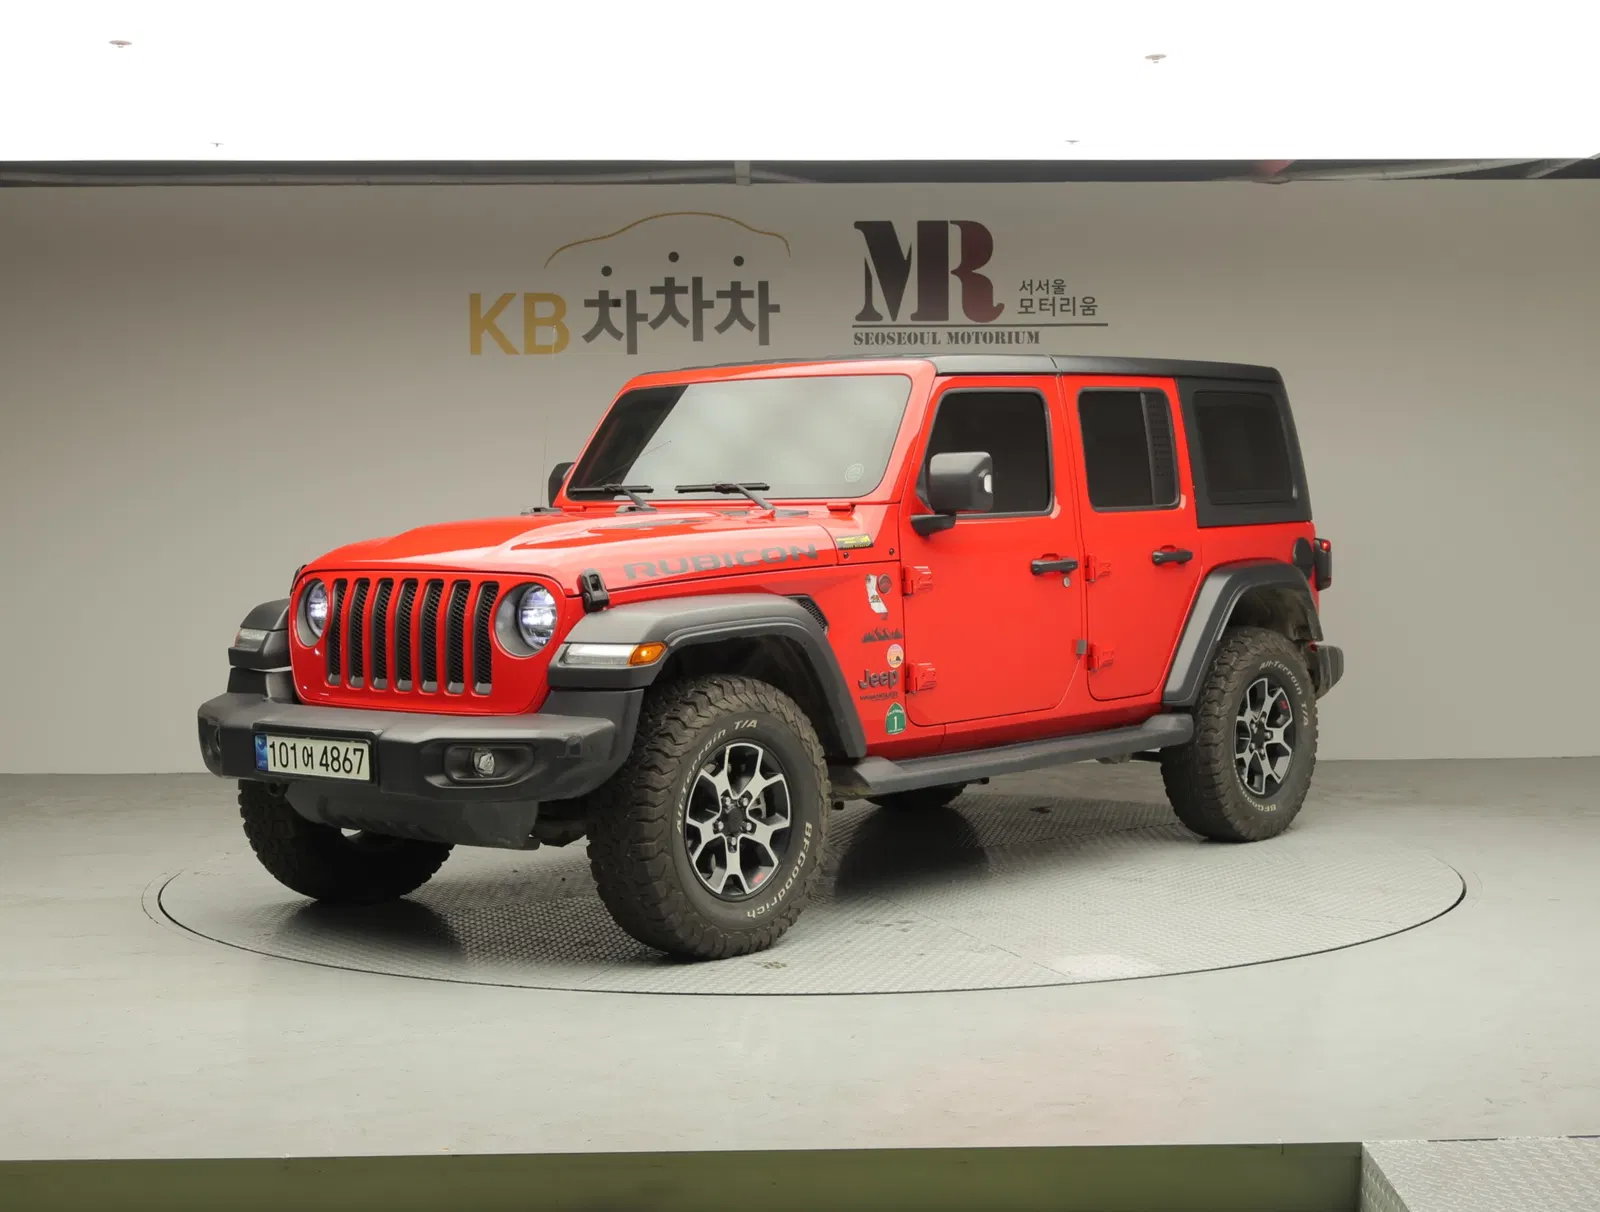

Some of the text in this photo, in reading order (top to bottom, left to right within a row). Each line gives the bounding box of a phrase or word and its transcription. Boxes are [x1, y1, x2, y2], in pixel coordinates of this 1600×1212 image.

[854, 220, 1005, 323] MR
[1019, 279, 1067, 295] 서서울
[469, 251, 781, 355] KB 차차차
[1017, 296, 1098, 317] 모터리움
[853, 331, 1040, 346] SEOSEOUL MOTORIUM
[623, 544, 818, 580] RUBICON
[858, 669, 899, 690] Jeep
[733, 719, 758, 730] T/A
[893, 716, 898, 731] 1
[269, 741, 364, 774] 101어 4867
[747, 822, 813, 918] BFGoodrich
